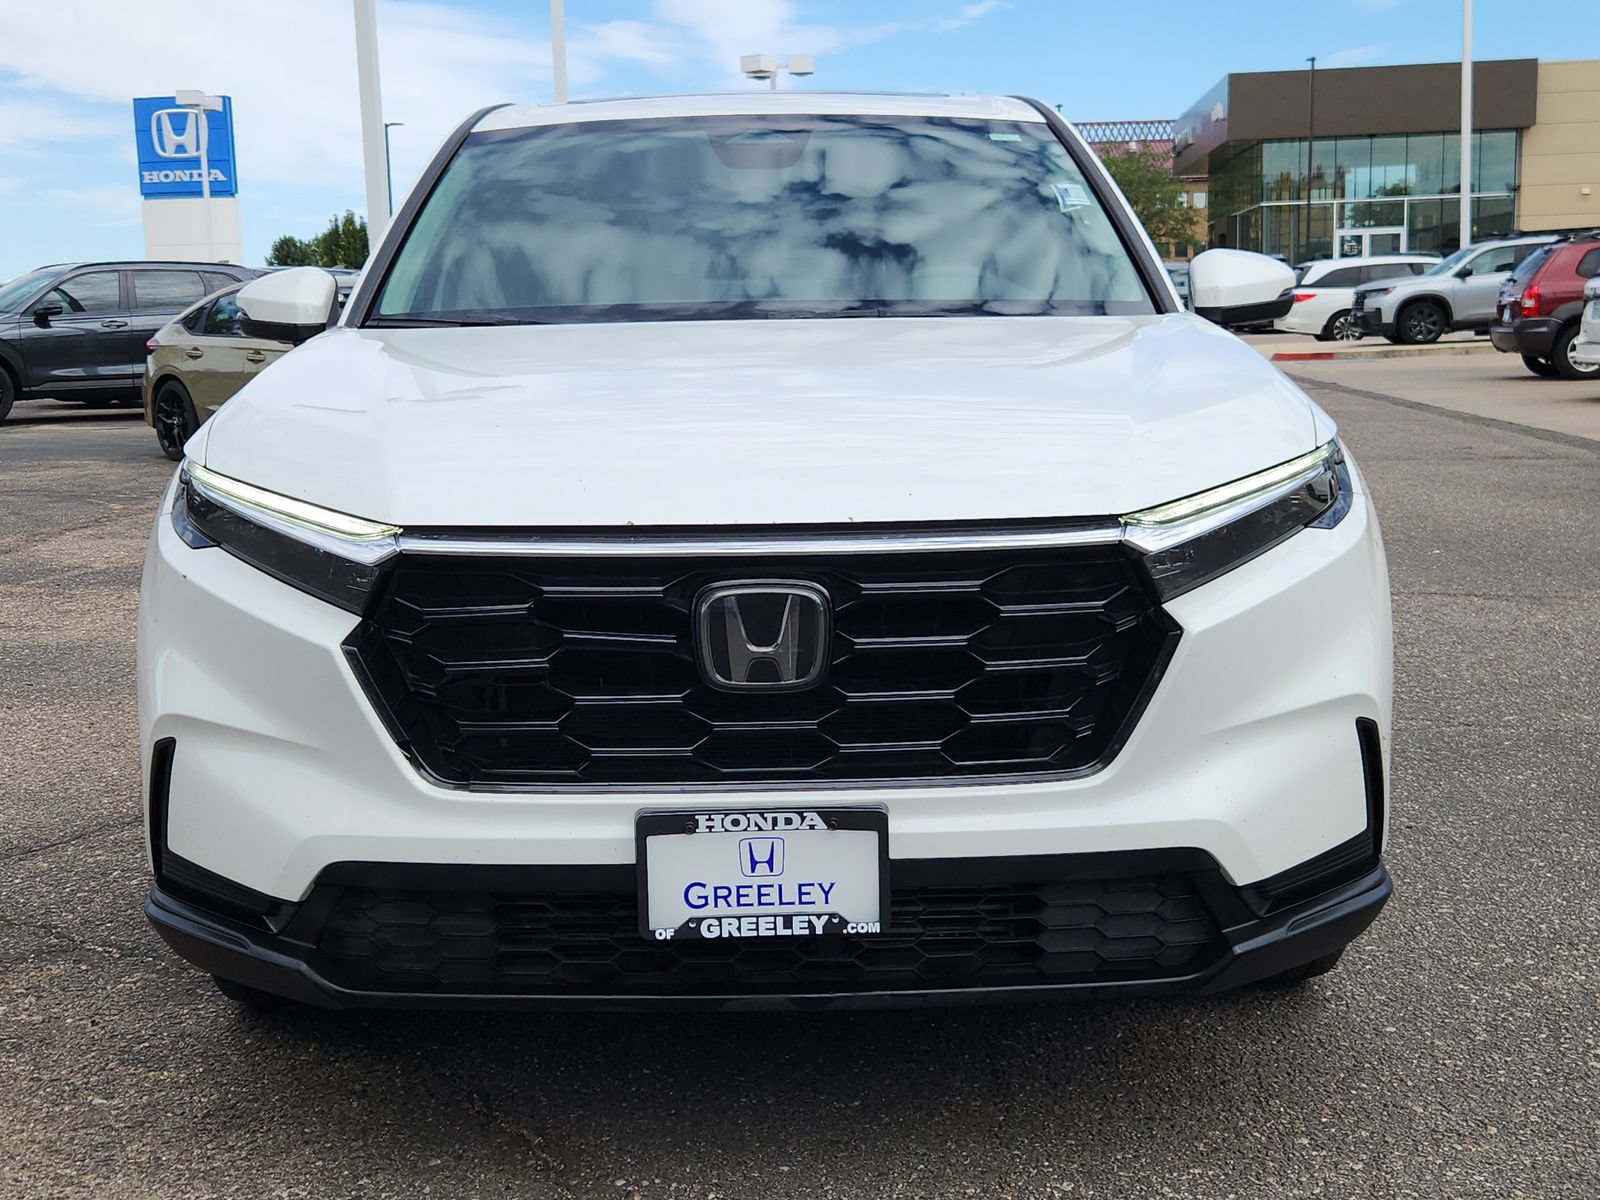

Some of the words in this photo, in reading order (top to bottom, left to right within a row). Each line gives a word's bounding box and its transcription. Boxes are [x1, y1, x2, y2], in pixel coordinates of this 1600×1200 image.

[142, 168, 227, 183] HONDA
[695, 812, 828, 832] HONDA
[683, 881, 837, 909] GREELEY
[654, 928, 675, 940] OF
[700, 914, 829, 939] GREELEY
[842, 921, 881, 934] .COM
